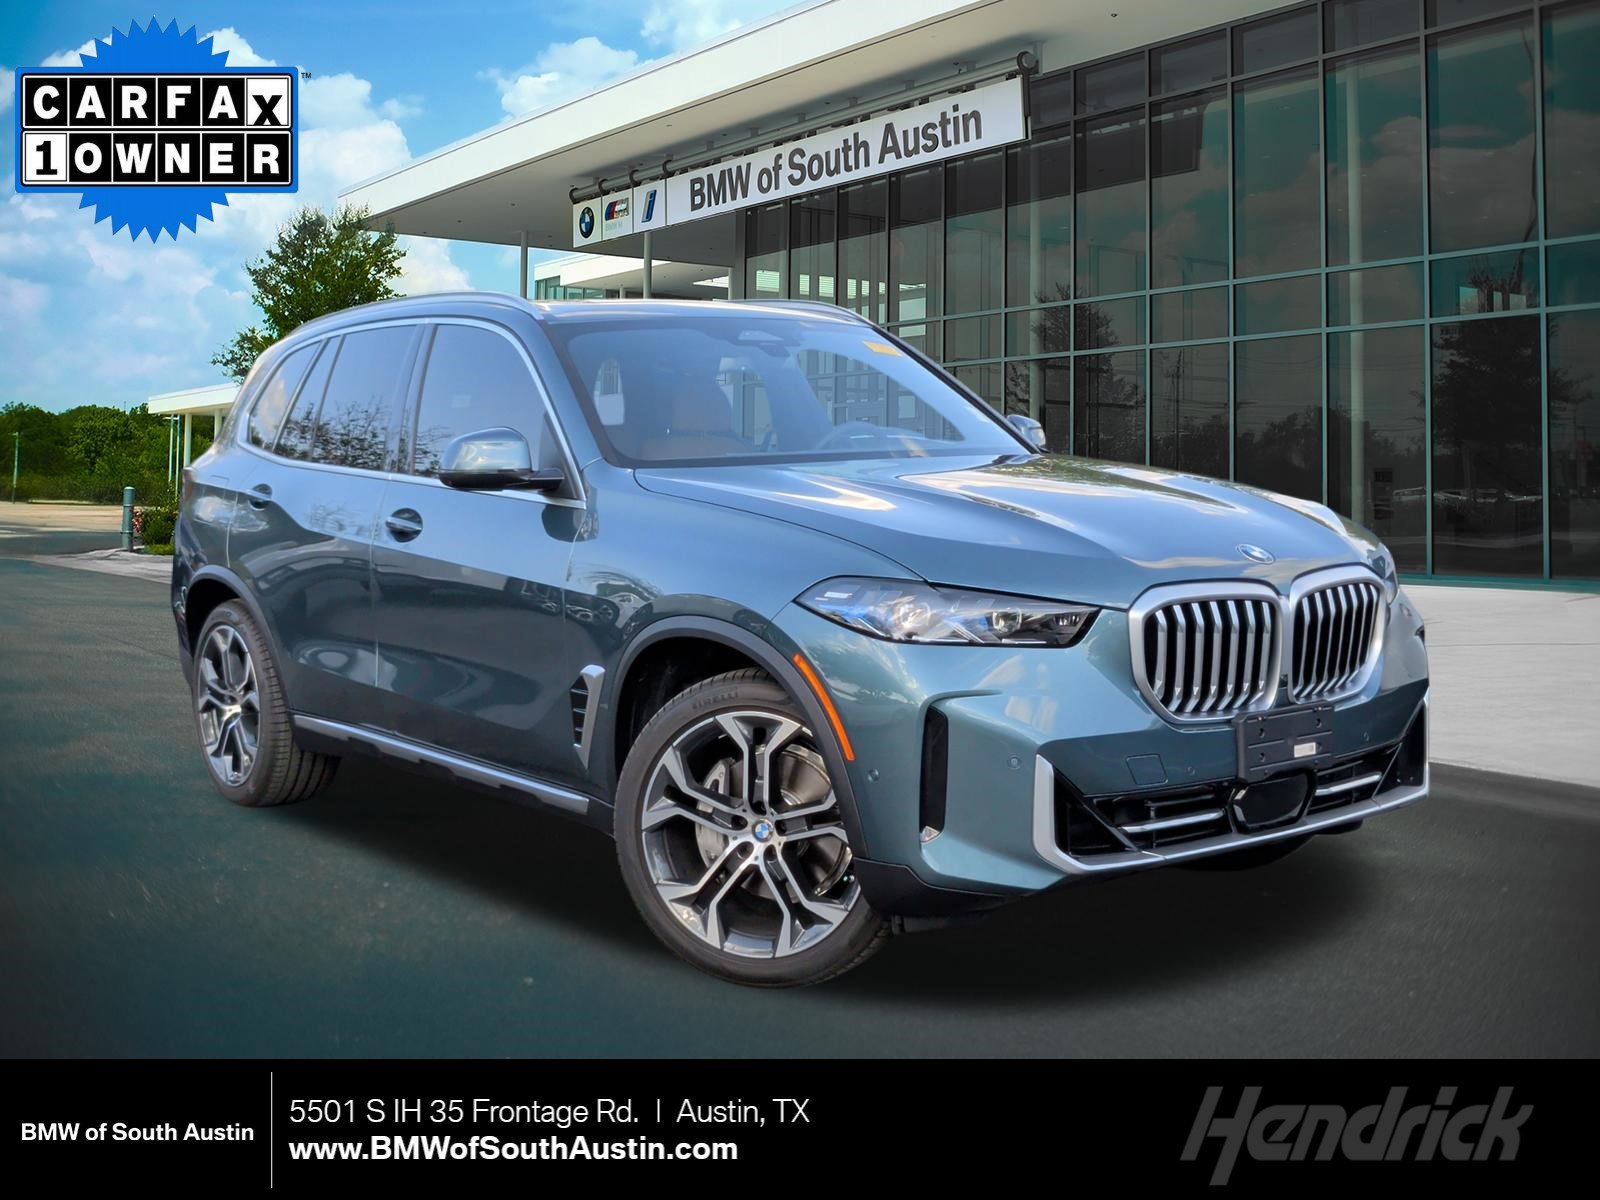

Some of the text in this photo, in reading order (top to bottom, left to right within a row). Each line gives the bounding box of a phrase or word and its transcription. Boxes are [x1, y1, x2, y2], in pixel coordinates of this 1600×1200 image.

[689, 103, 983, 212] BMW of South Austin
